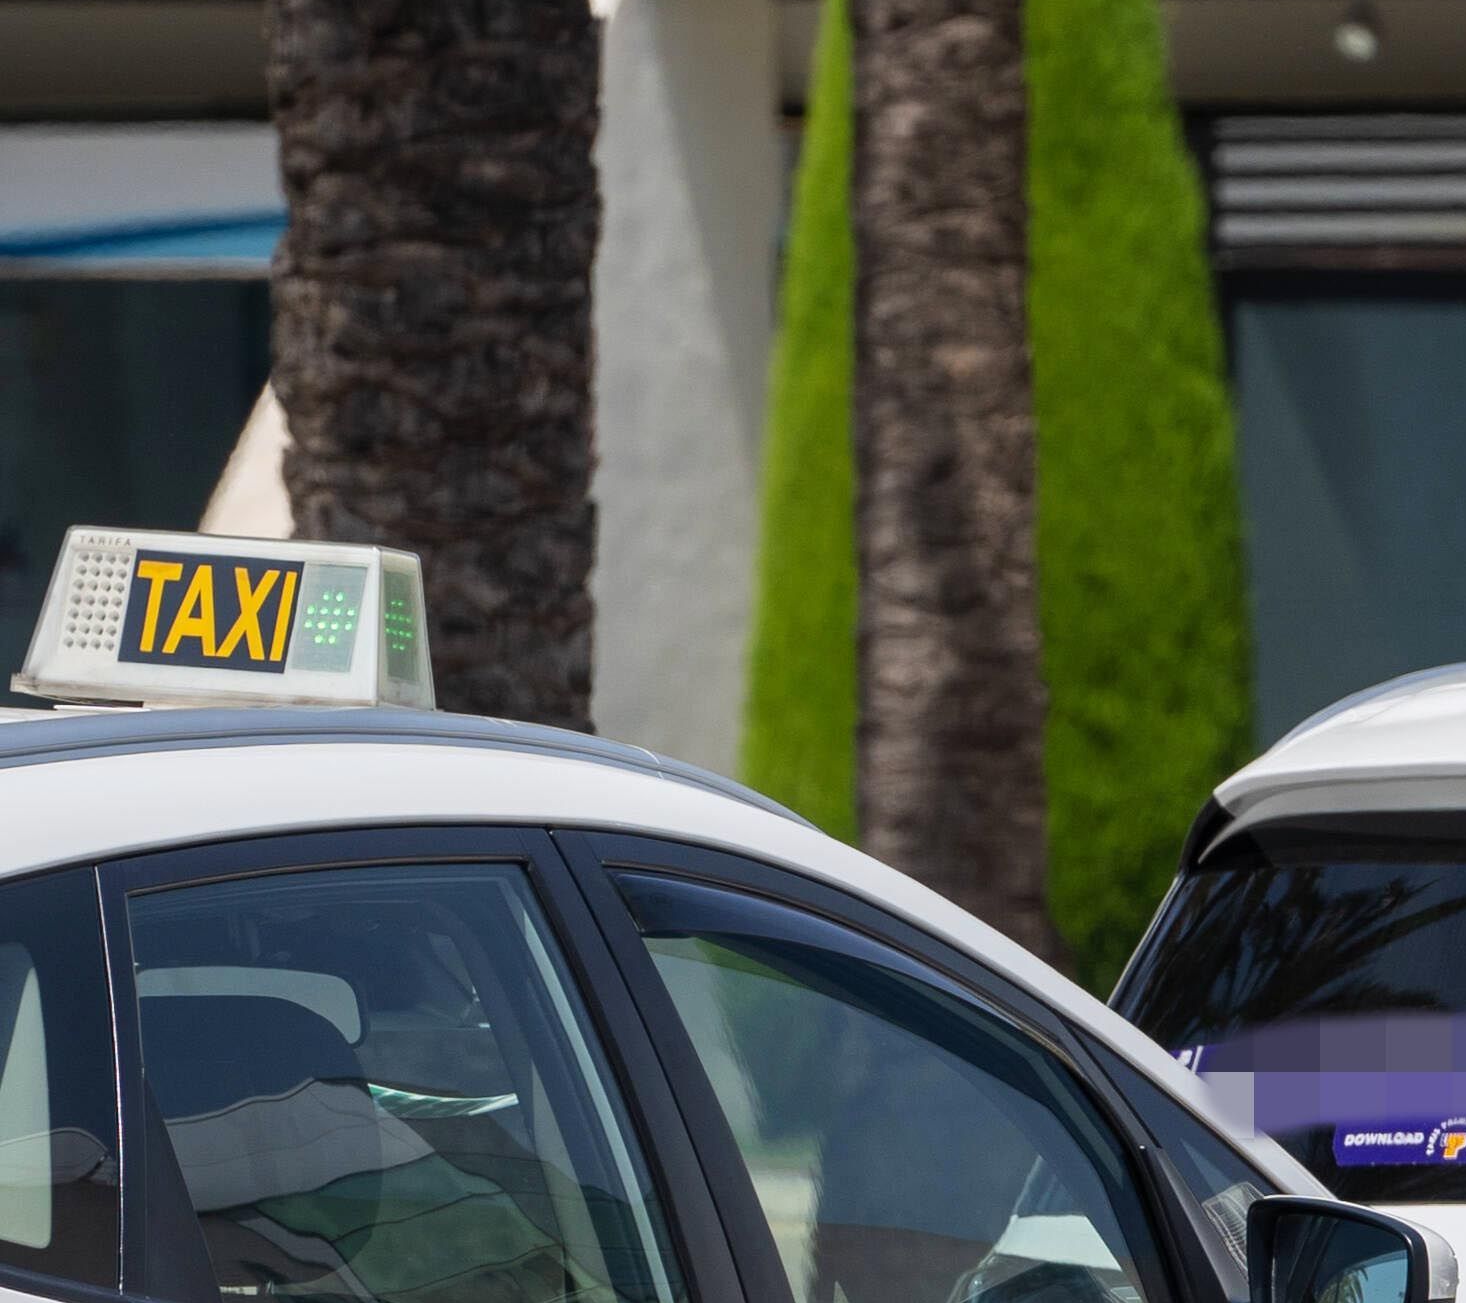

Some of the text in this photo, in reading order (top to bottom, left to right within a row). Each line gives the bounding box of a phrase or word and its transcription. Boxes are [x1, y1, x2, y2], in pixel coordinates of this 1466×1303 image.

[80, 535, 132, 546] TARIFA
[137, 560, 298, 662] TAXI
[1344, 1131, 1424, 1146] DOWNLOAD
